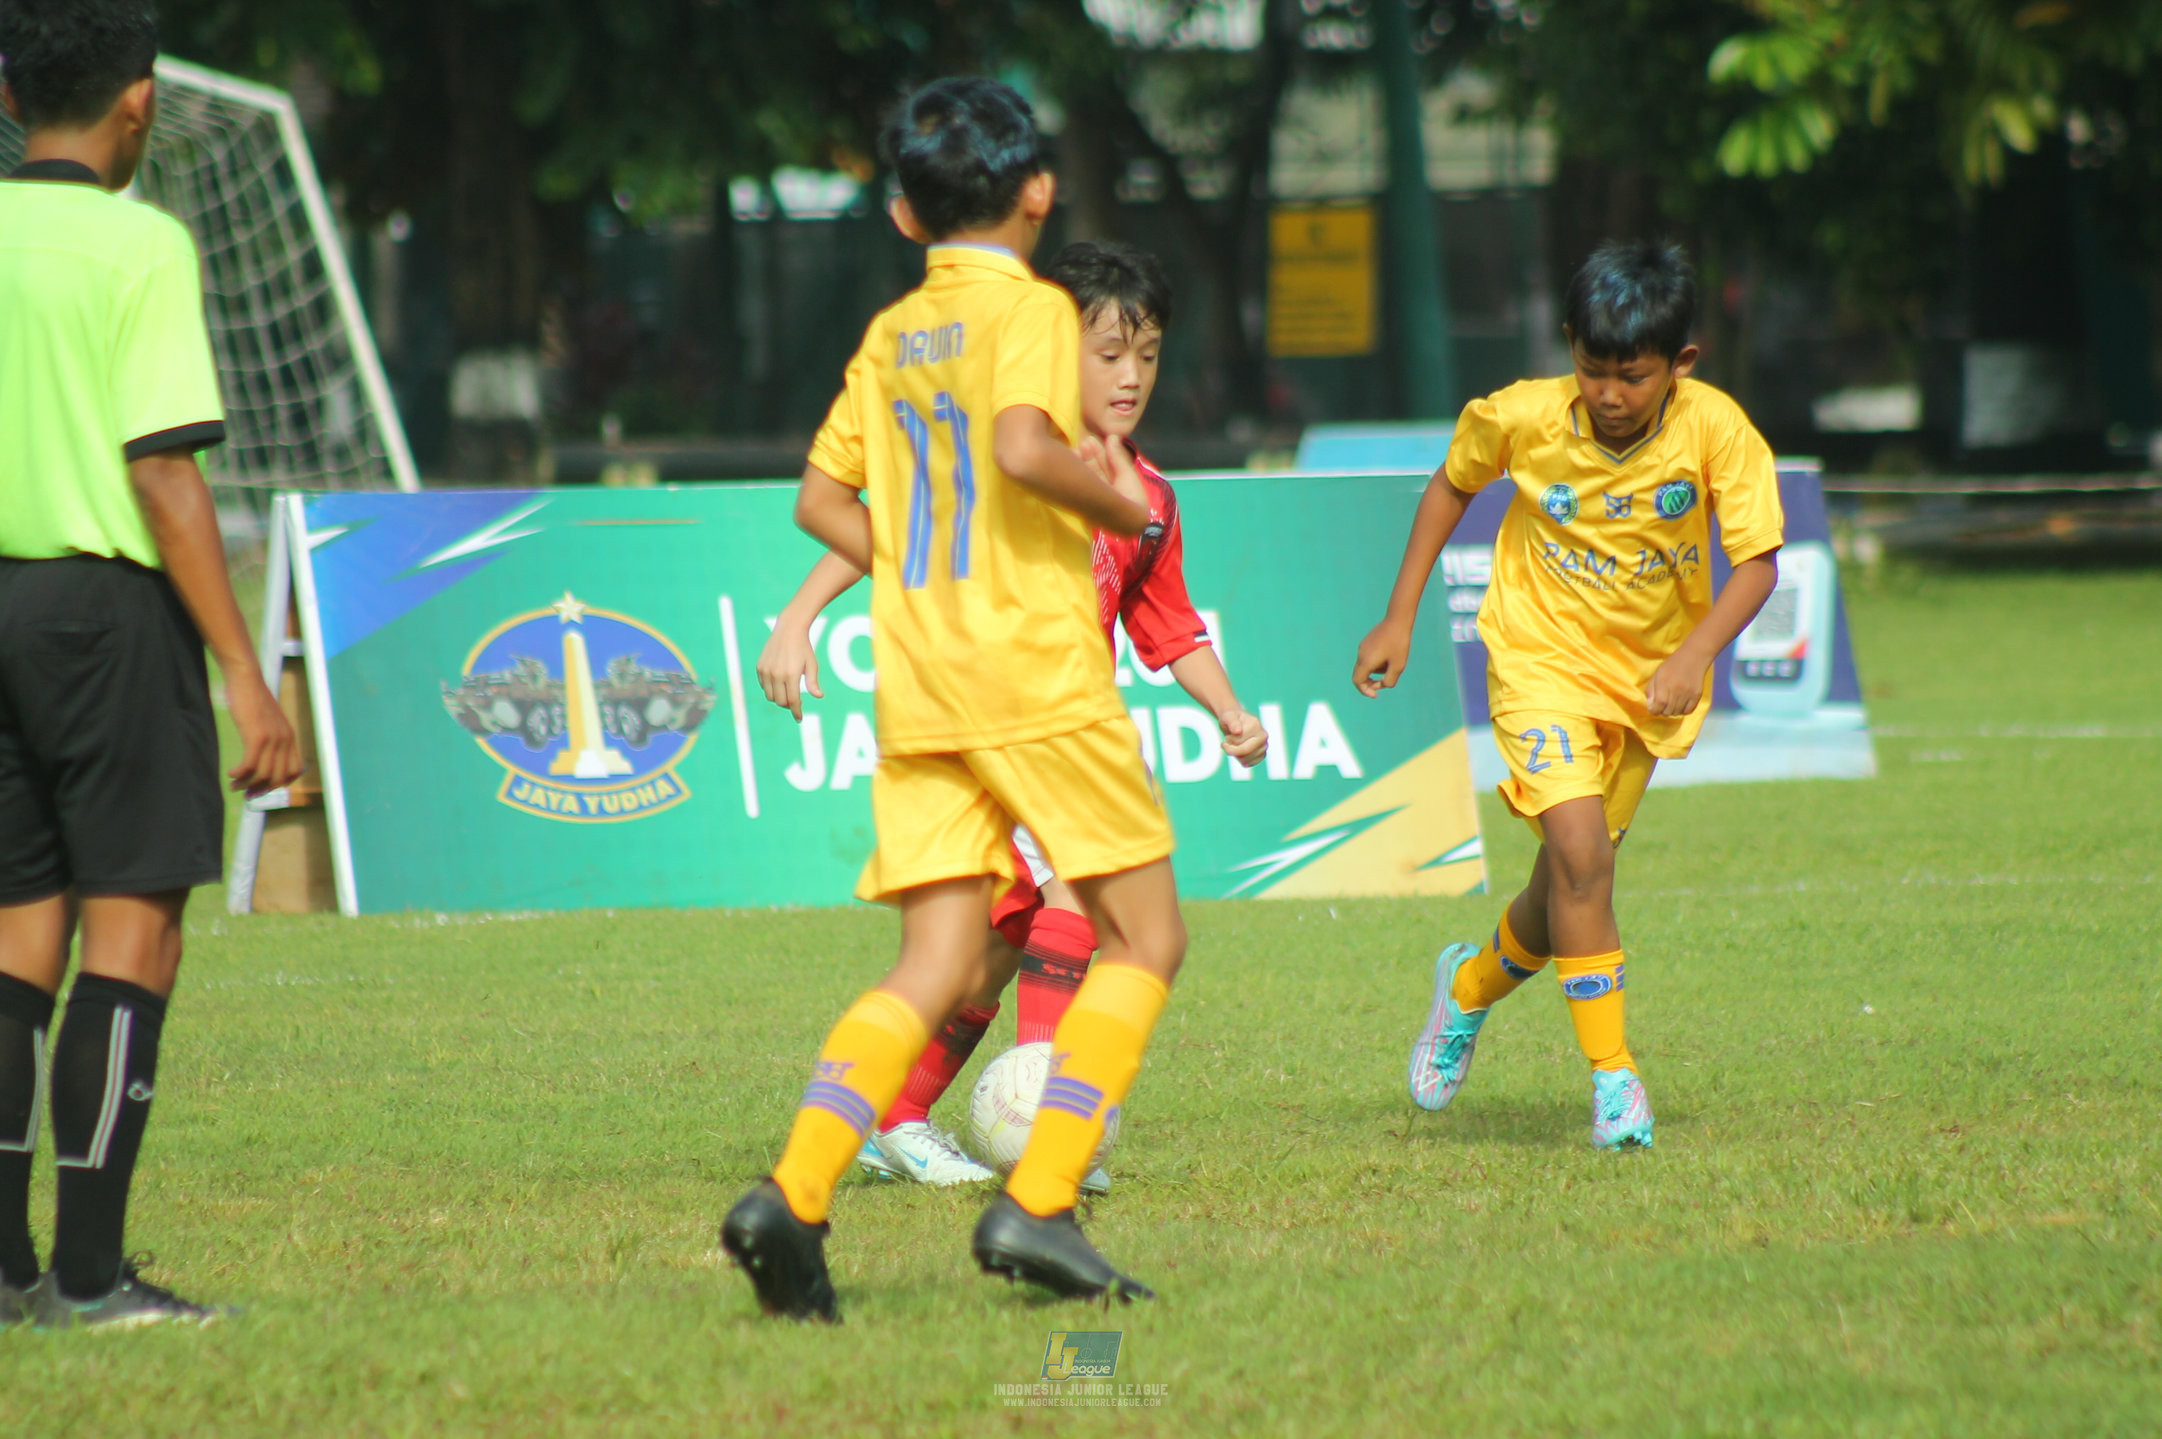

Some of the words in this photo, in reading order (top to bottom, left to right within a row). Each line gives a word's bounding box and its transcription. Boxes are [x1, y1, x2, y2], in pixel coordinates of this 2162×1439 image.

[892, 391, 976, 590] 11
[1543, 541, 1617, 576] PAM
[1633, 541, 1700, 577] JAYA
[1518, 724, 1574, 775] 21
[513, 781, 582, 815] JAYA
[582, 777, 676, 816] YUDHA
